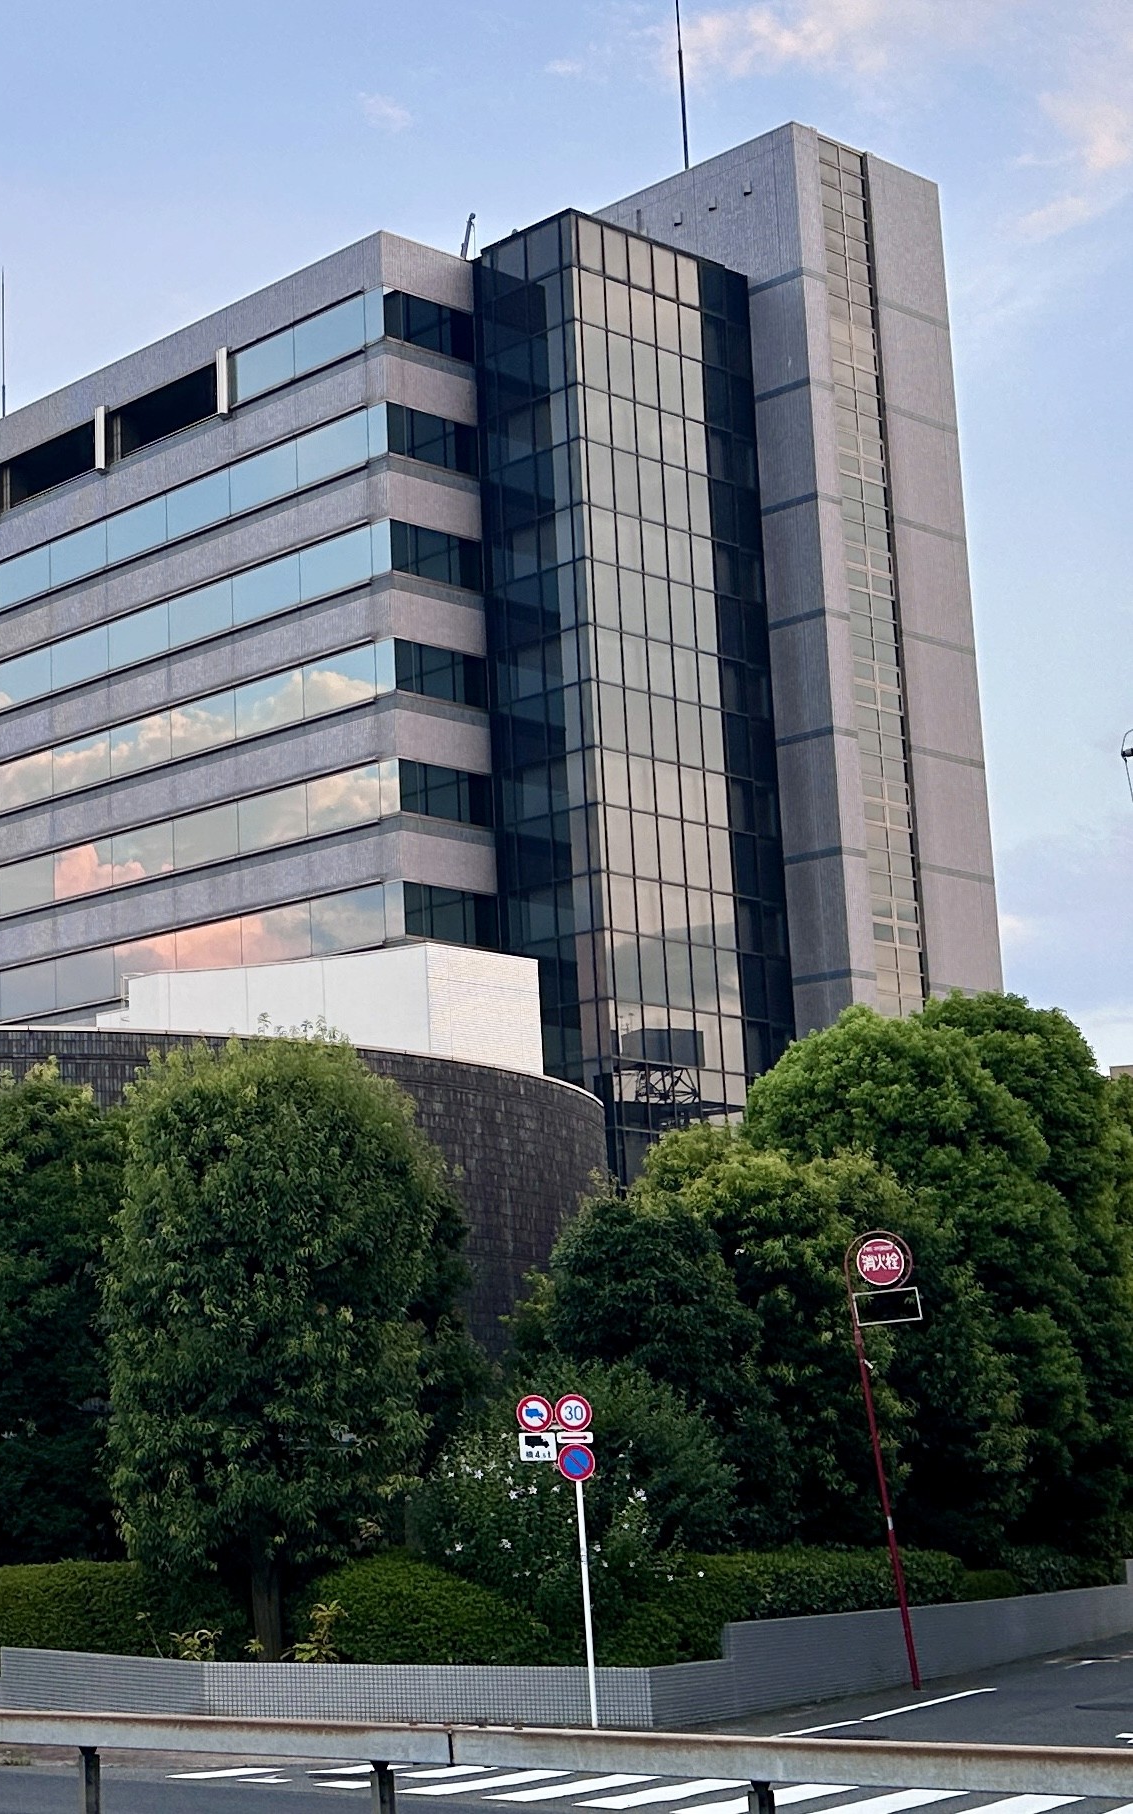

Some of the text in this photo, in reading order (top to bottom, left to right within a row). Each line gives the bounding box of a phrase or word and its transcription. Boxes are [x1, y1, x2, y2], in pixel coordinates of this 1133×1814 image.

[861, 1252, 900, 1272] 消火栓
[564, 1405, 584, 1421] 30
